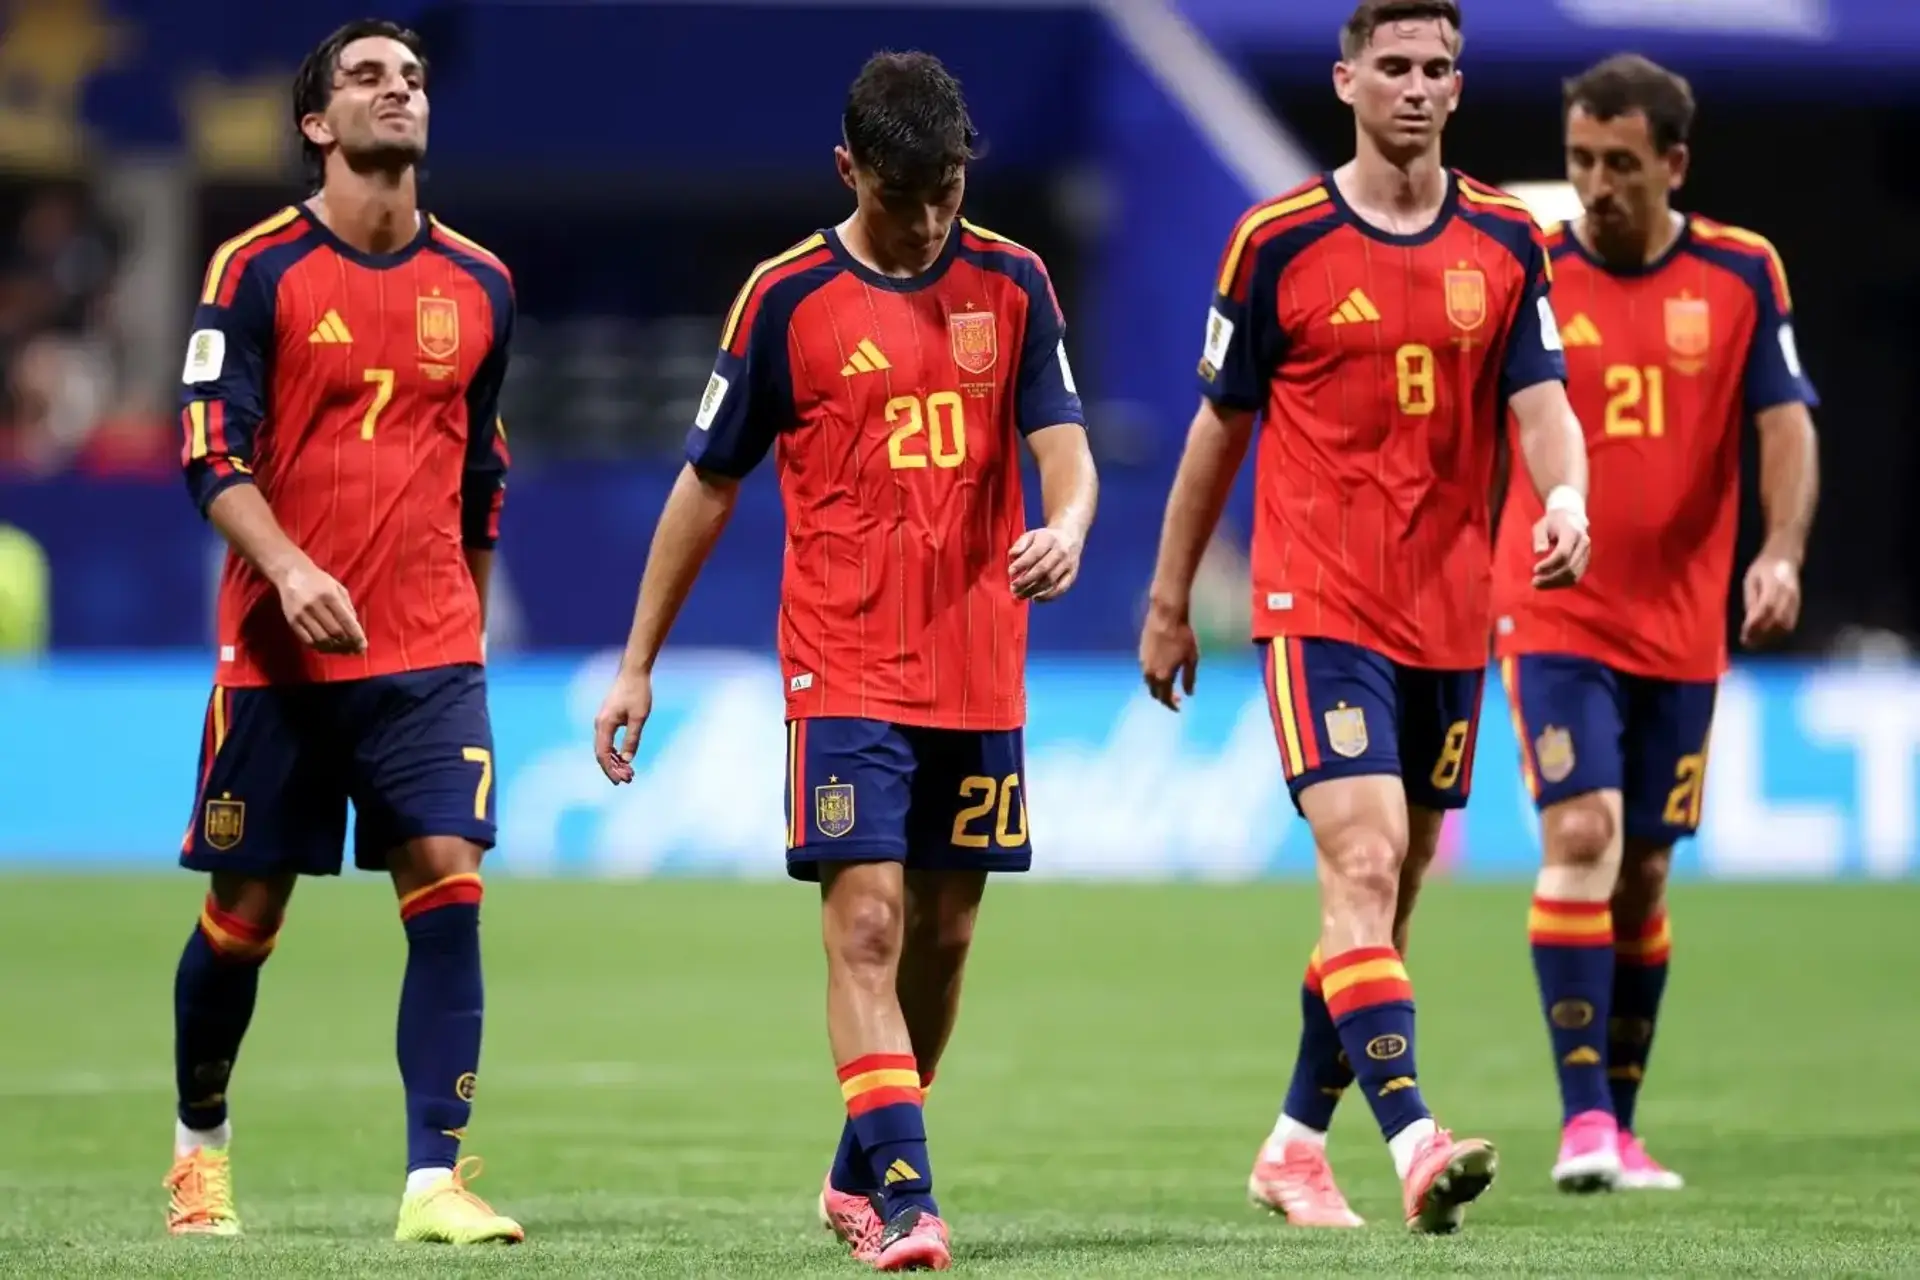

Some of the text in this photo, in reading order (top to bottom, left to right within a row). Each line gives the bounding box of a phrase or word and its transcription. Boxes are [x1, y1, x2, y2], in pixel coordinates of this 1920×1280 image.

[361, 369, 395, 440] 7
[1396, 344, 1434, 414] 8
[1605, 365, 1664, 437] 21
[885, 391, 966, 469] 20
[462, 746, 492, 820] 7
[1430, 720, 1469, 789] 8
[951, 773, 1027, 848] 20
